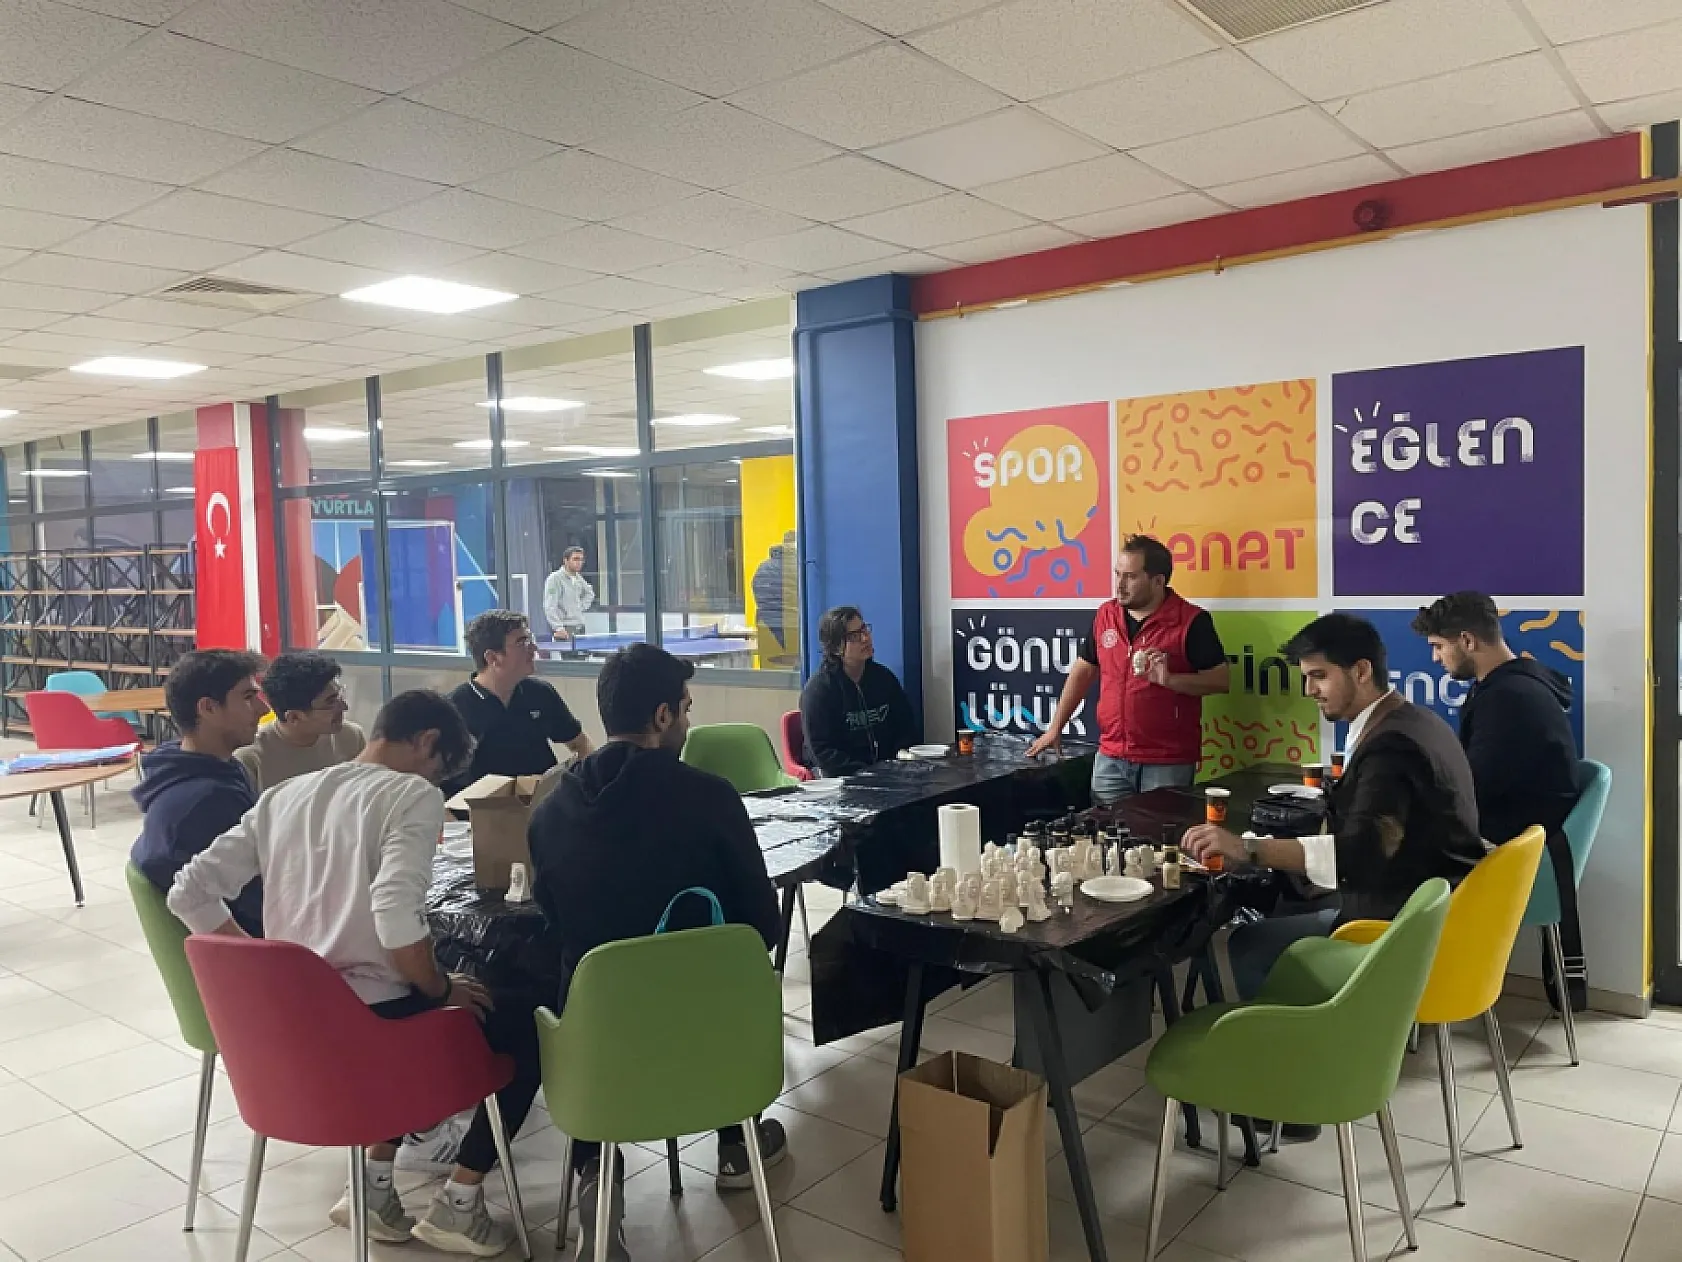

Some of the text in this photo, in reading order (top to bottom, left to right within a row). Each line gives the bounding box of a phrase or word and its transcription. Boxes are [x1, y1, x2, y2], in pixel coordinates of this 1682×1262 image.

[973, 444, 1083, 488] SPOR
[1351, 412, 1534, 473] EĞLEN
[1351, 498, 1422, 545] CE
[1146, 528, 1305, 571] ANAT
[967, 627, 1086, 674] GÖNÜ
